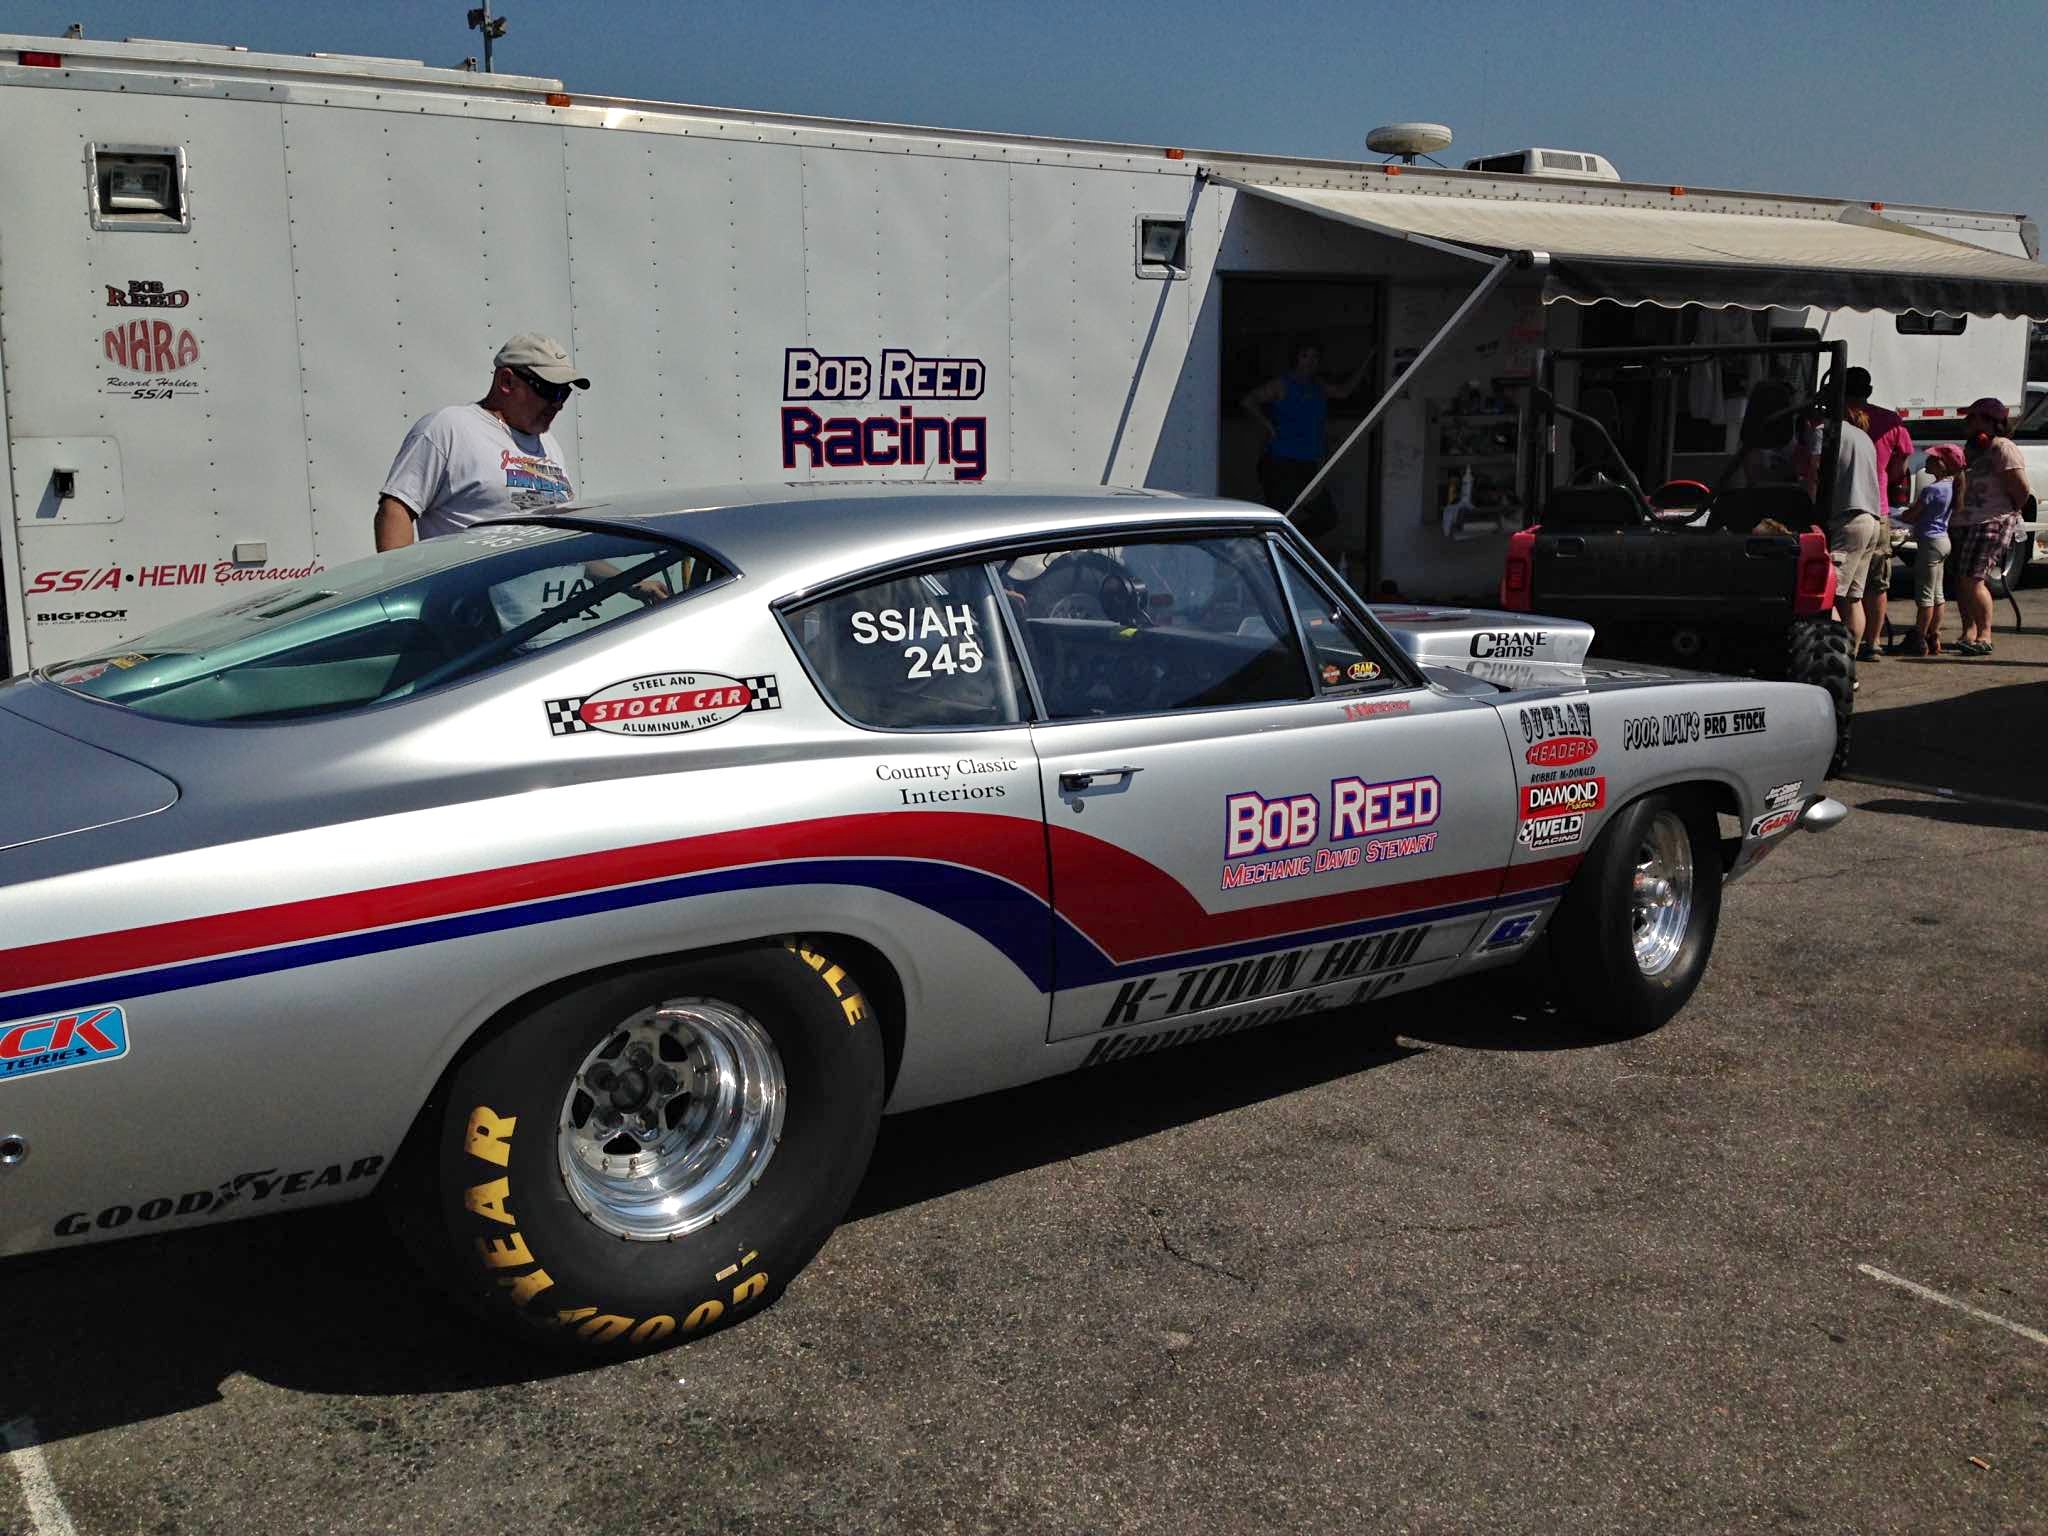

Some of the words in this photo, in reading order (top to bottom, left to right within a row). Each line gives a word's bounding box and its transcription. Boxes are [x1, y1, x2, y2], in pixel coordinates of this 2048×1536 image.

[105, 285, 189, 308] REED
[128, 280, 164, 293] BOB
[104, 319, 199, 373] NHRA
[106, 378, 150, 387] Record
[155, 378, 199, 387] Holder
[784, 348, 871, 401] BOB
[880, 349, 986, 400] REED
[131, 389, 174, 399] SS/A
[781, 405, 987, 481] Racing
[27, 567, 121, 594] SS/A
[138, 564, 206, 587] HEMI
[37, 609, 128, 621] BIGFOOT
[851, 604, 975, 644] SS/AH
[904, 642, 984, 679] 245
[1354, 664, 1372, 672] RAM
[632, 679, 666, 692] STEEL
[670, 676, 696, 686] AND
[593, 696, 680, 720] STOCK
[693, 689, 742, 708] CAR
[622, 717, 694, 732] ALUMINUM,
[698, 712, 722, 726] INC.
[1520, 702, 1592, 743] OUTLAW
[1624, 717, 1660, 750] POOR
[1662, 711, 1700, 746] MAN'S
[1704, 716, 1727, 735] PRO
[1733, 711, 1766, 732] STOCK
[1529, 740, 1595, 763] HEADERS
[876, 764, 951, 781] Country
[956, 756, 1018, 776] Classic
[1530, 770, 1557, 784] ROBBIE
[899, 783, 1006, 805] Interiors
[1530, 781, 1599, 808] DIAMOND
[1225, 791, 1320, 860] BOB
[1330, 775, 1441, 841] REED
[1535, 817, 1582, 838] WELD
[1533, 834, 1580, 847] RACING
[1221, 856, 1312, 890] MECHANIC
[1314, 847, 1360, 873] DAVID
[1365, 832, 1438, 863] STEWART
[1102, 947, 1312, 1028] K-TOWN
[1312, 925, 1432, 982] HEMI
[54, 1155, 385, 1237] GOODYEAR
